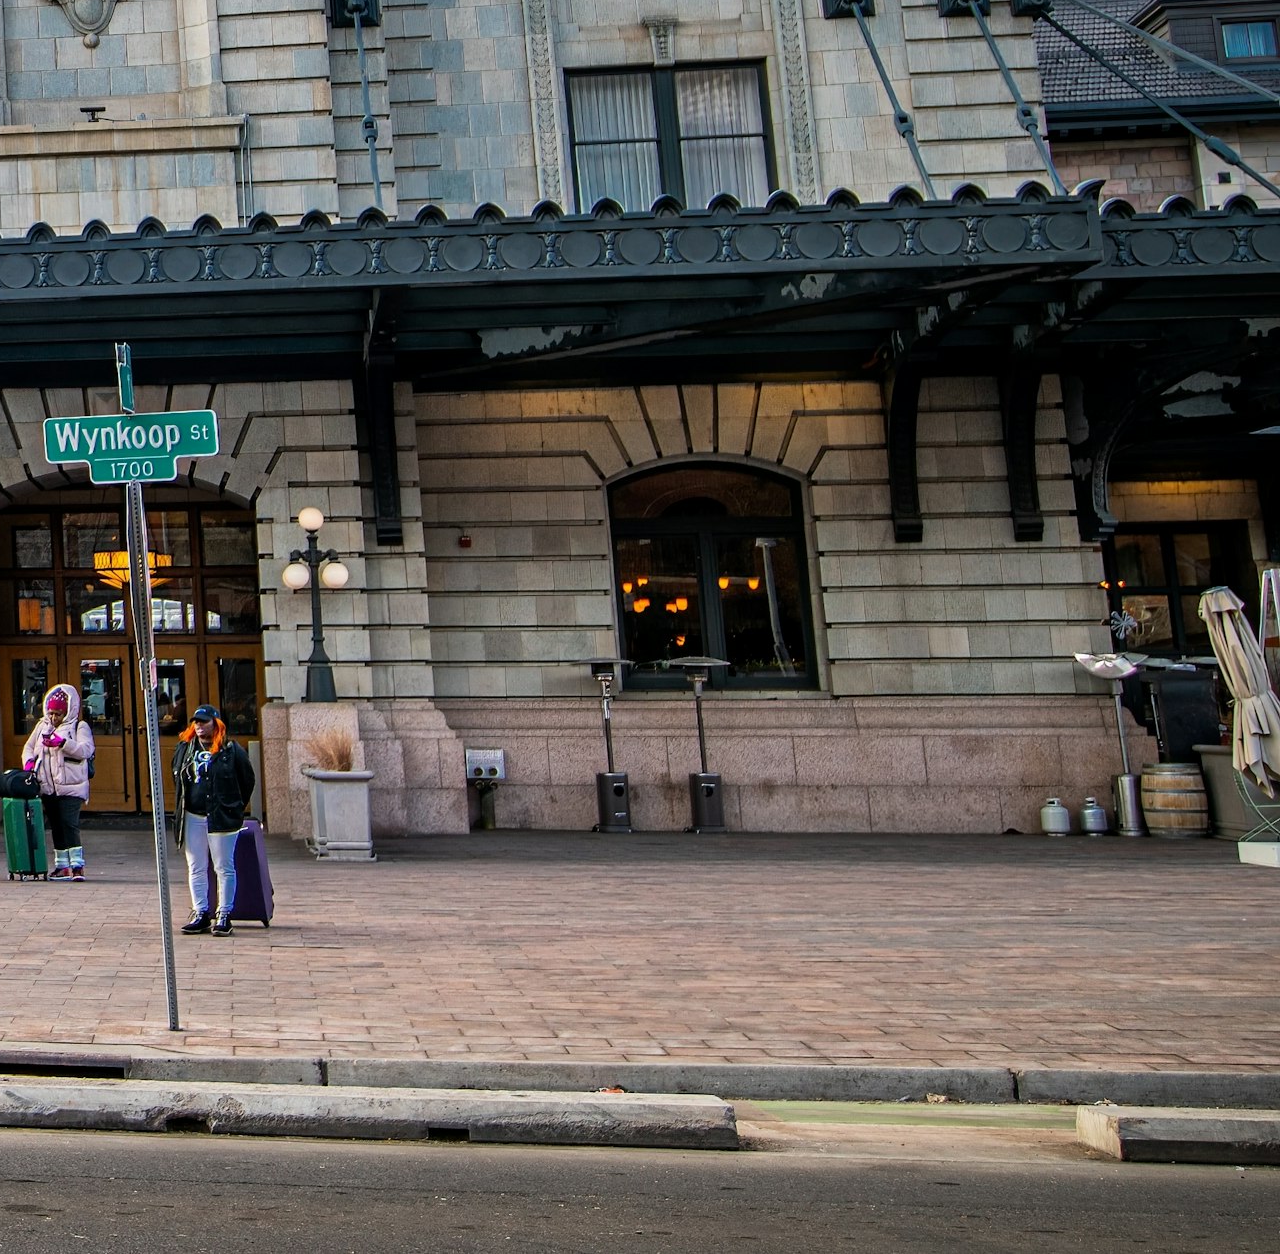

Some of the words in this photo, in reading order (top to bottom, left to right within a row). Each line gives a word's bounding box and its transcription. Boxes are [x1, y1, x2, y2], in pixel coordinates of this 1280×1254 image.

[55, 420, 181, 455] Wynkoop
[190, 424, 209, 440] St
[111, 461, 154, 478] 1700
